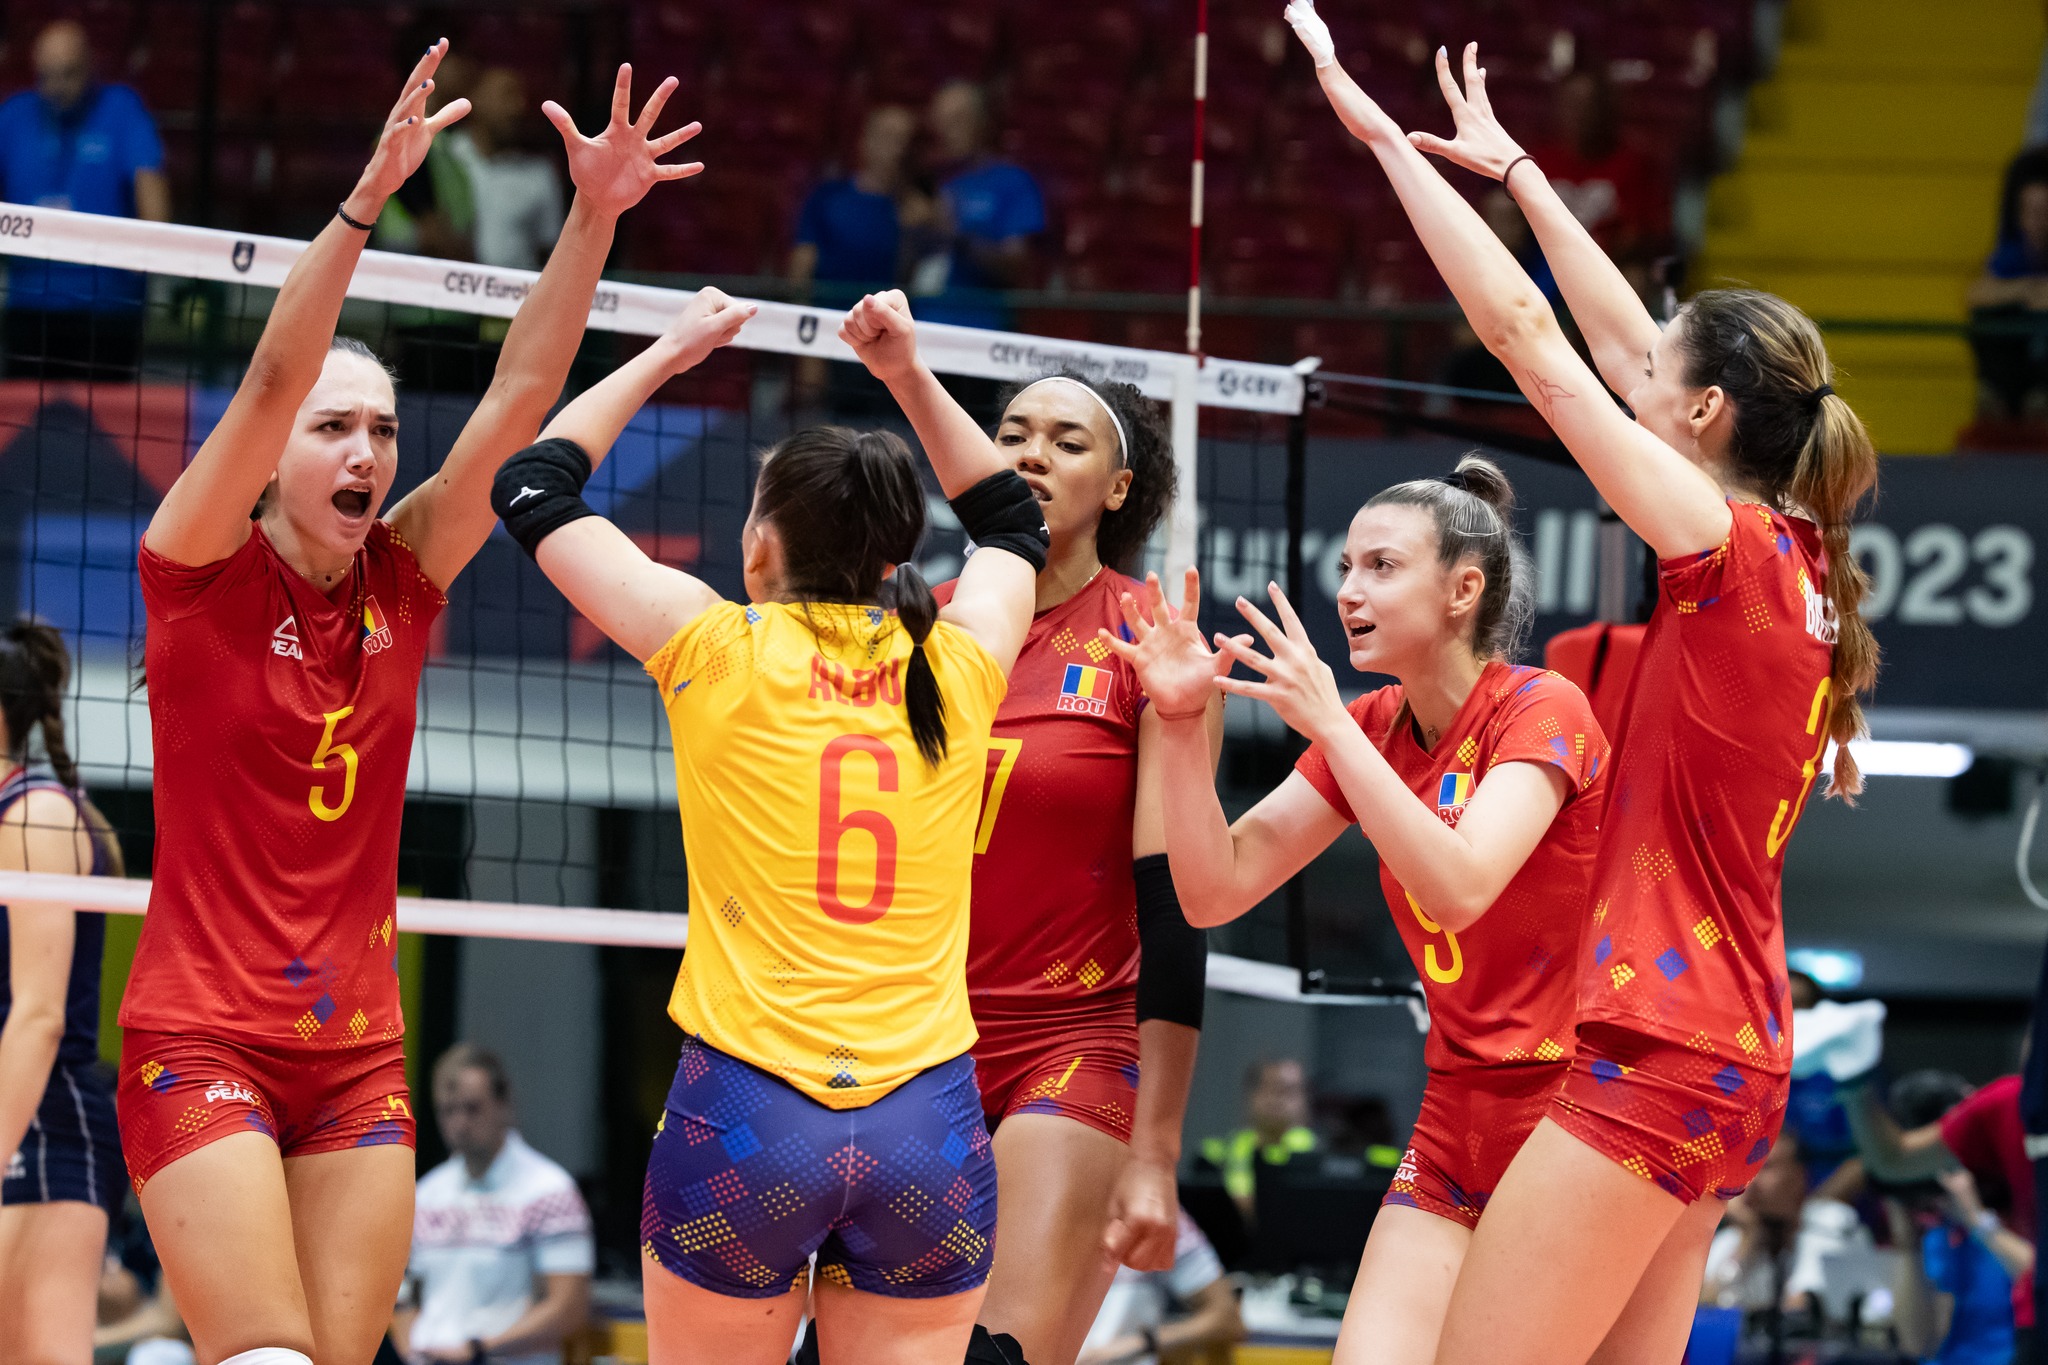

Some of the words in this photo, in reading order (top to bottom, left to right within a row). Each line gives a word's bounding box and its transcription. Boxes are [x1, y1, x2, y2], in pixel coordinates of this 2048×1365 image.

[0, 214, 34, 239] 023
[444, 270, 483, 296] CEV
[1849, 522, 2035, 628] 023
[807, 650, 902, 708] ALBU
[1056, 694, 1107, 717] ROU
[308, 705, 359, 822] 5
[1766, 676, 1834, 859] 3
[973, 736, 1023, 855] 7
[1437, 803, 1470, 825] RO
[816, 733, 899, 926] 6
[205, 1087, 256, 1103] PEAK
